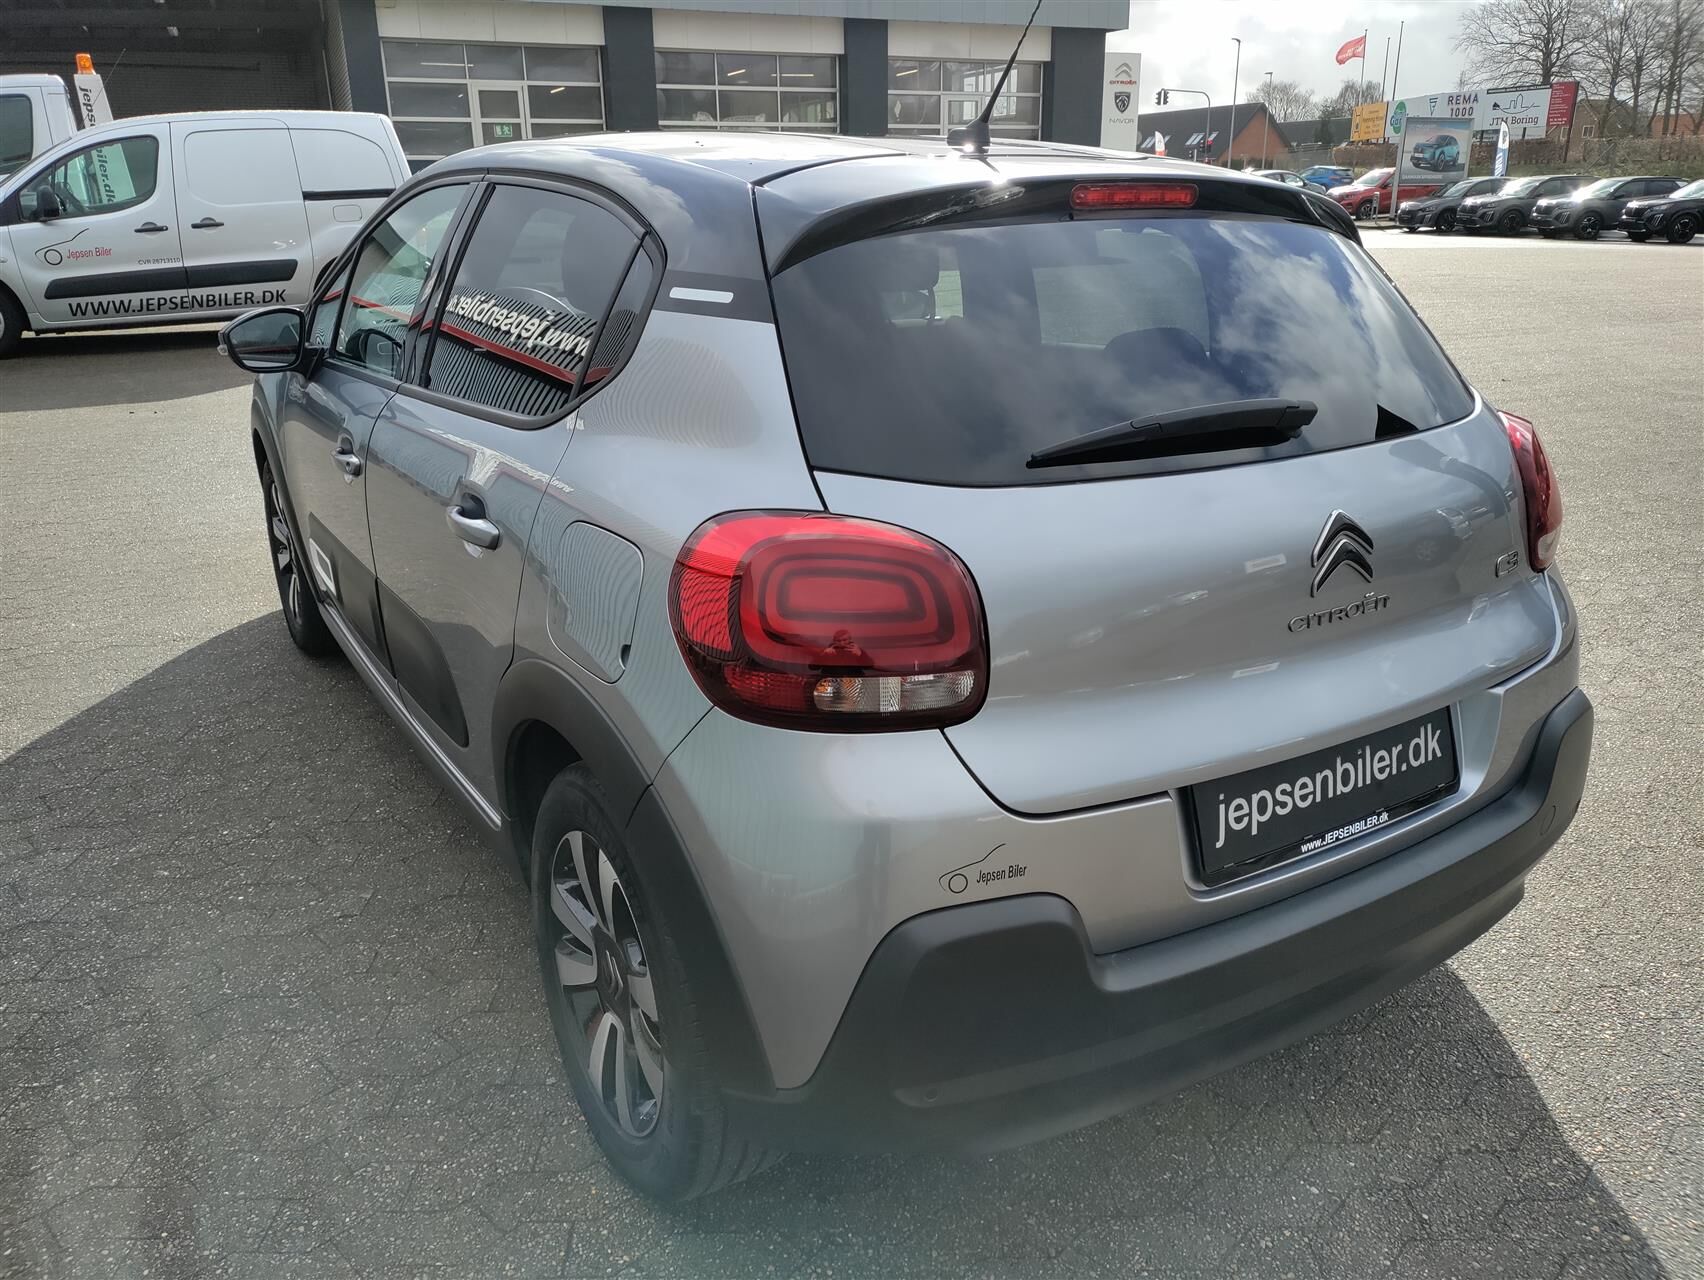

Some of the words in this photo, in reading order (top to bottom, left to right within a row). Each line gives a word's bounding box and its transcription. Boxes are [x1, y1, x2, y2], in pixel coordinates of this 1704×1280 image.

[1447, 94, 1479, 105] REMA
[1450, 107, 1474, 118] 1000
[1489, 116, 1508, 127] JTM
[1511, 115, 1539, 126] Boring
[67, 249, 93, 260] Jepsen
[95, 246, 112, 257] Biler
[68, 289, 287, 317] WWW.JEPSENBILER.DK
[1495, 550, 1519, 578] C3
[1287, 592, 1390, 632] CITROËN
[1215, 723, 1443, 849] jepsenbiler.dk
[1300, 811, 1389, 853] www.JEPSENBILER.dk
[976, 869, 1006, 885] Jepsen
[1007, 864, 1027, 879] Biler
